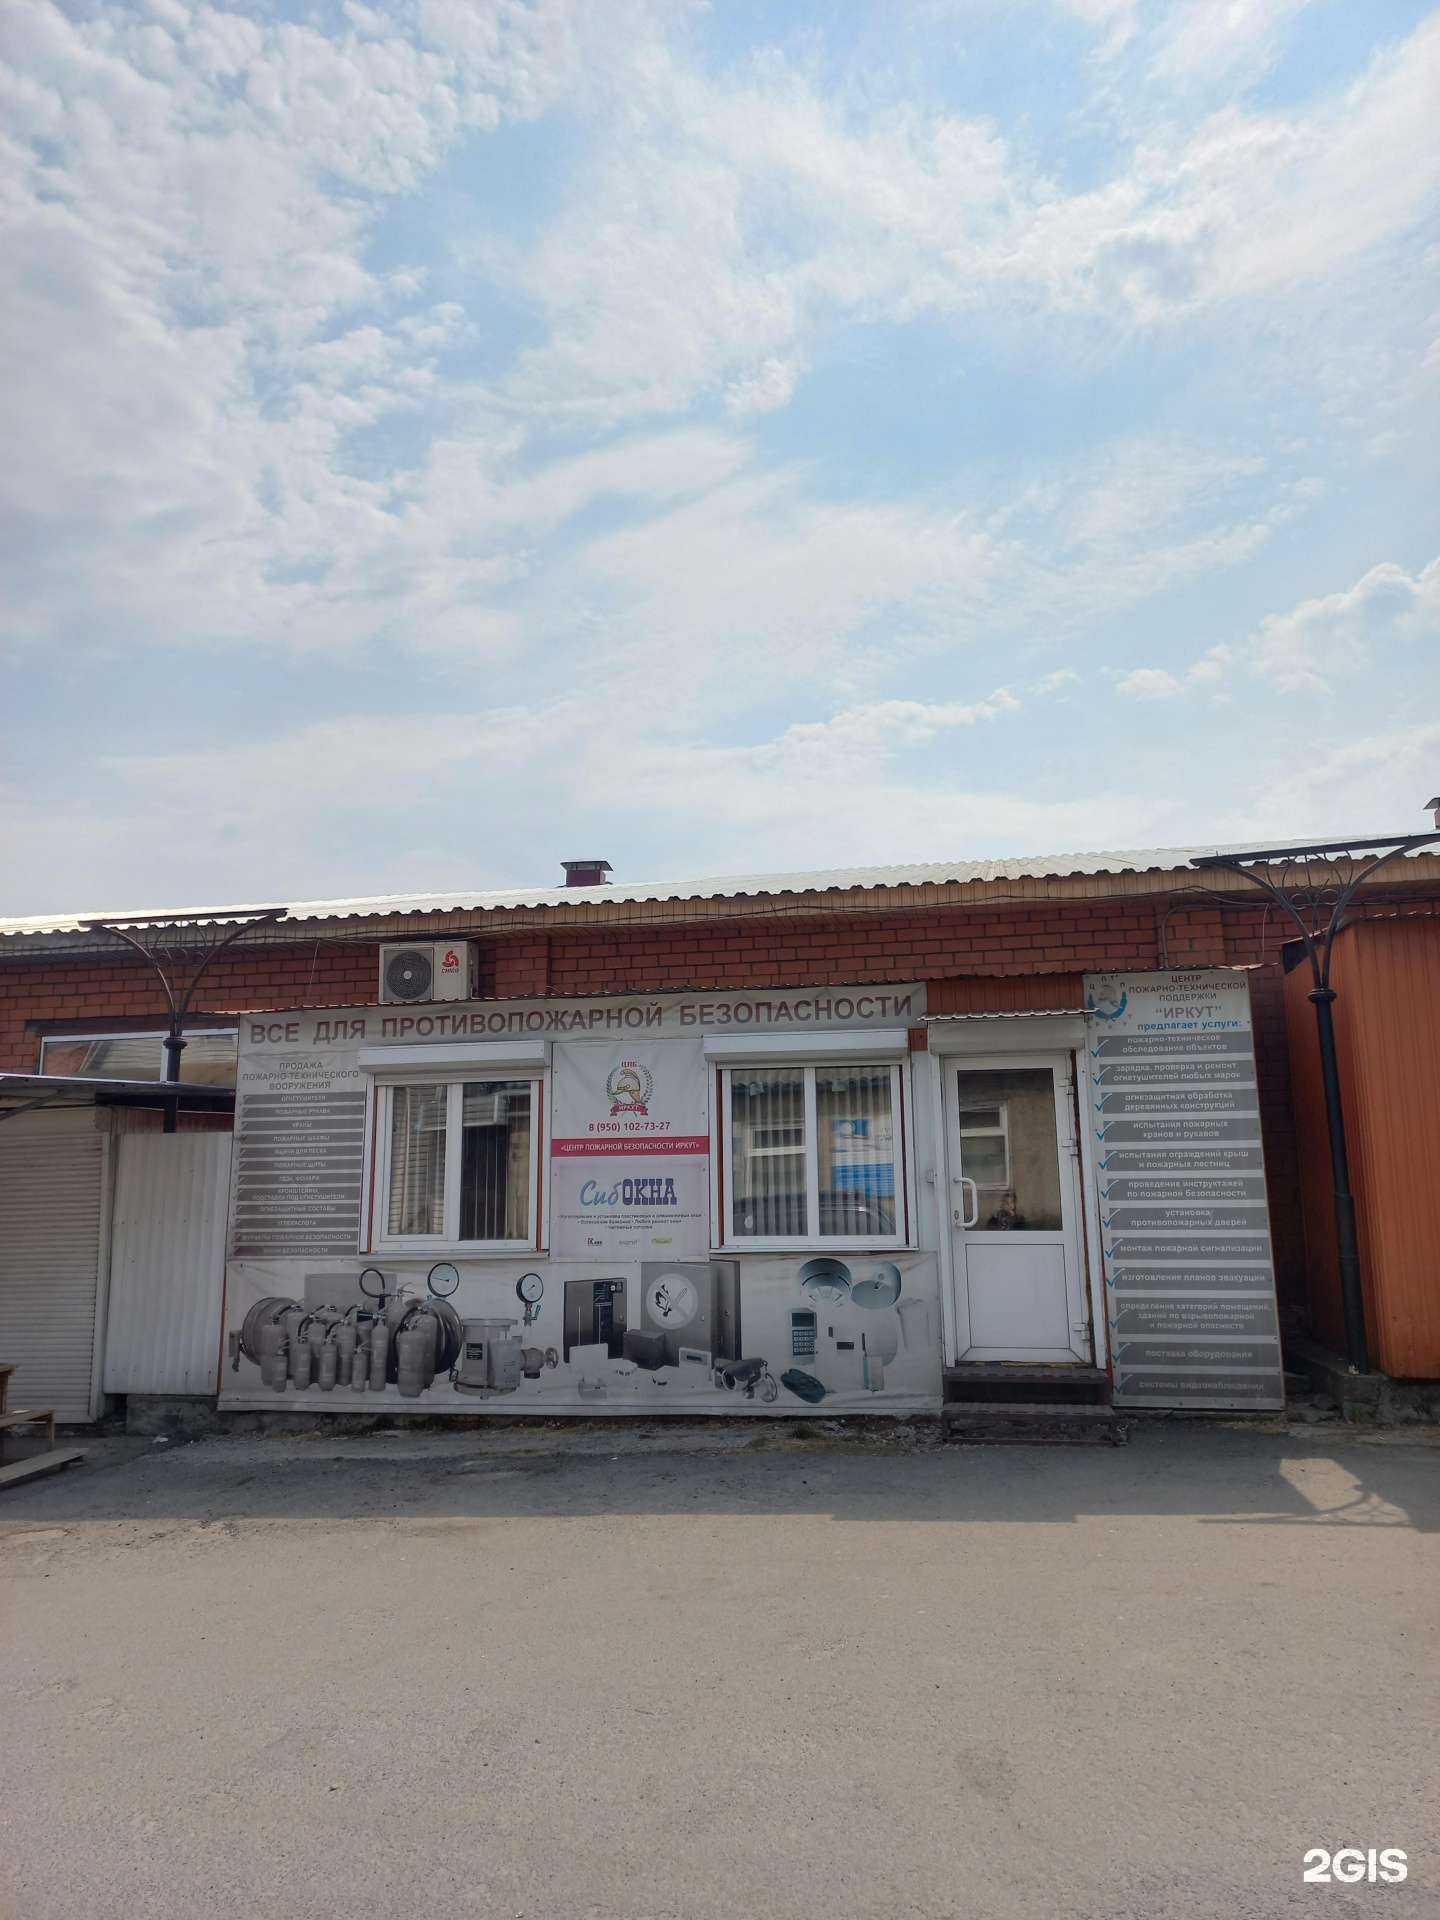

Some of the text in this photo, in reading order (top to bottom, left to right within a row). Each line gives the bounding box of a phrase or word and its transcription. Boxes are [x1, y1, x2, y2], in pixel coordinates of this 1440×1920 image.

[1171, 974, 1202, 984] ЦЕНТР
[1128, 982, 1247, 994] ПОЖАРНО-ТЕХНИЧЕСКОЙ
[1159, 992, 1217, 1002] ПОДДЕРЖКИ
[250, 995, 912, 1045] ВСЕ ДЛЯ ПРОТИВОПОЖАРНОЙ БЕЗОПАСНОСТИ
[1137, 1020, 1199, 1032] предлагает
[1201, 1019, 1243, 1030] услуги:
[279, 1061, 323, 1071] ПРОДАЖА
[269, 1081, 331, 1090] ВООРУЖЕНИЯ
[588, 1121, 671, 1133] 8 (950) 102-73-27
